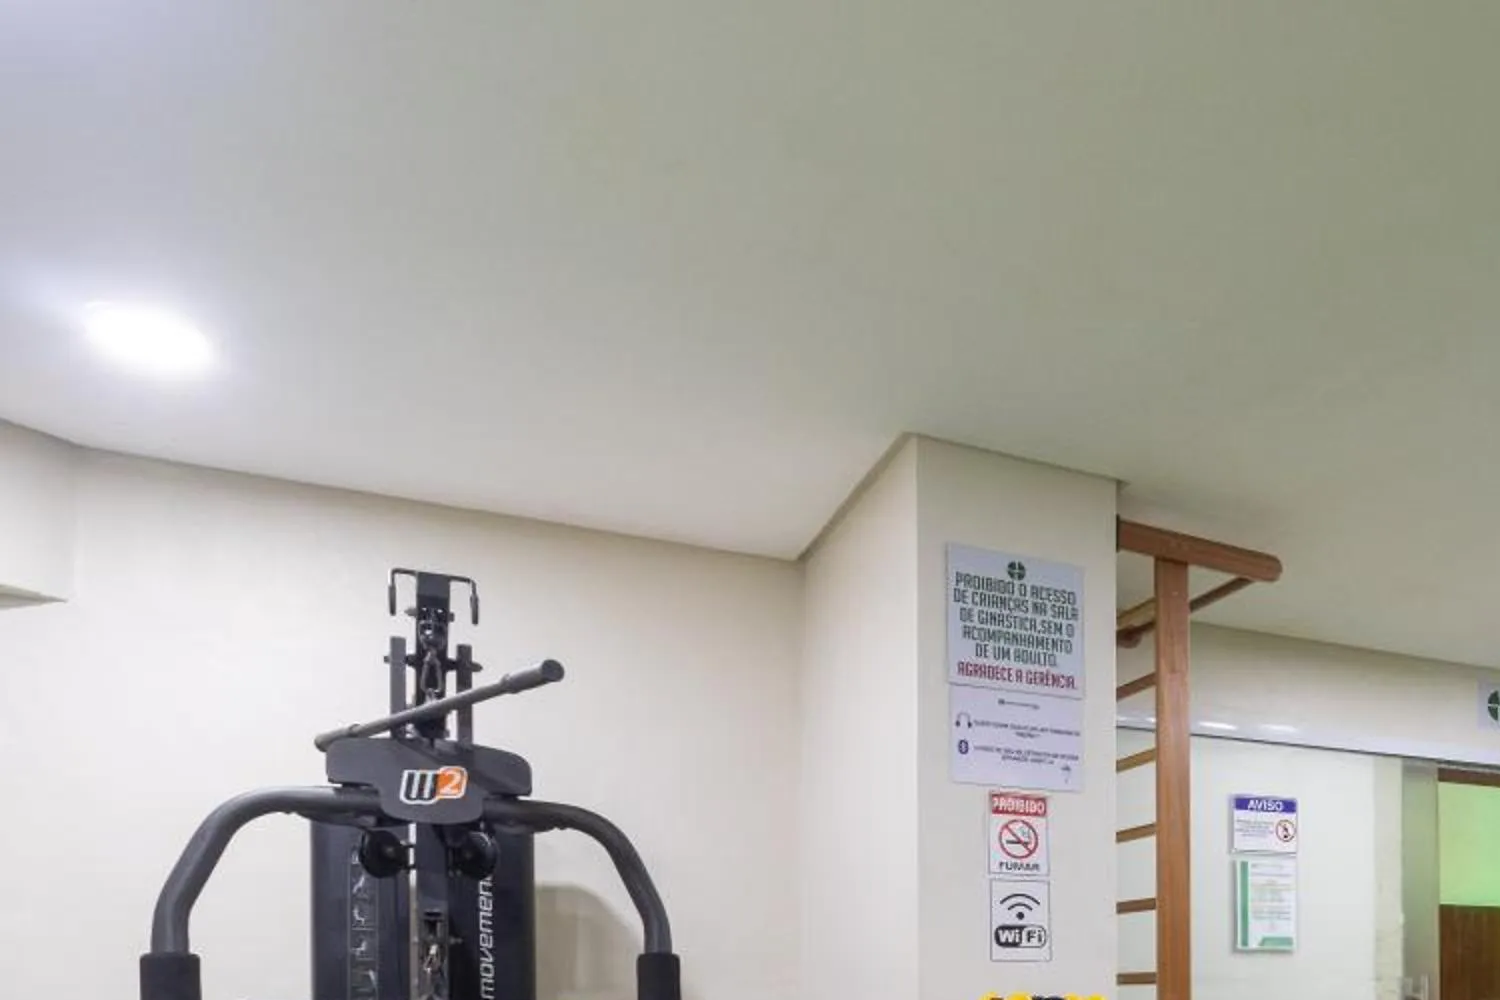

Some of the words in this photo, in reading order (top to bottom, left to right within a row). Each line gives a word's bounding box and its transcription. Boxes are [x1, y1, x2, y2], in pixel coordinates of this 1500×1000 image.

[955, 570, 1015, 597] PROIBIDO
[1018, 583, 1027, 597] O
[1030, 584, 1076, 606] ACESSO
[953, 587, 969, 605] DE
[1031, 601, 1047, 616] NA
[1050, 603, 1079, 621] SALA
[960, 606, 974, 623] DE
[1065, 623, 1075, 638] O
[962, 624, 1073, 654] ACOMPANHAMENTO
[975, 642, 989, 659] DE
[993, 645, 1011, 661] UM
[957, 661, 1013, 683] AGRADECE
[1015, 668, 1023, 683] A
[1247, 799, 1284, 812] AVISO
[478, 873, 495, 1000] movemen
